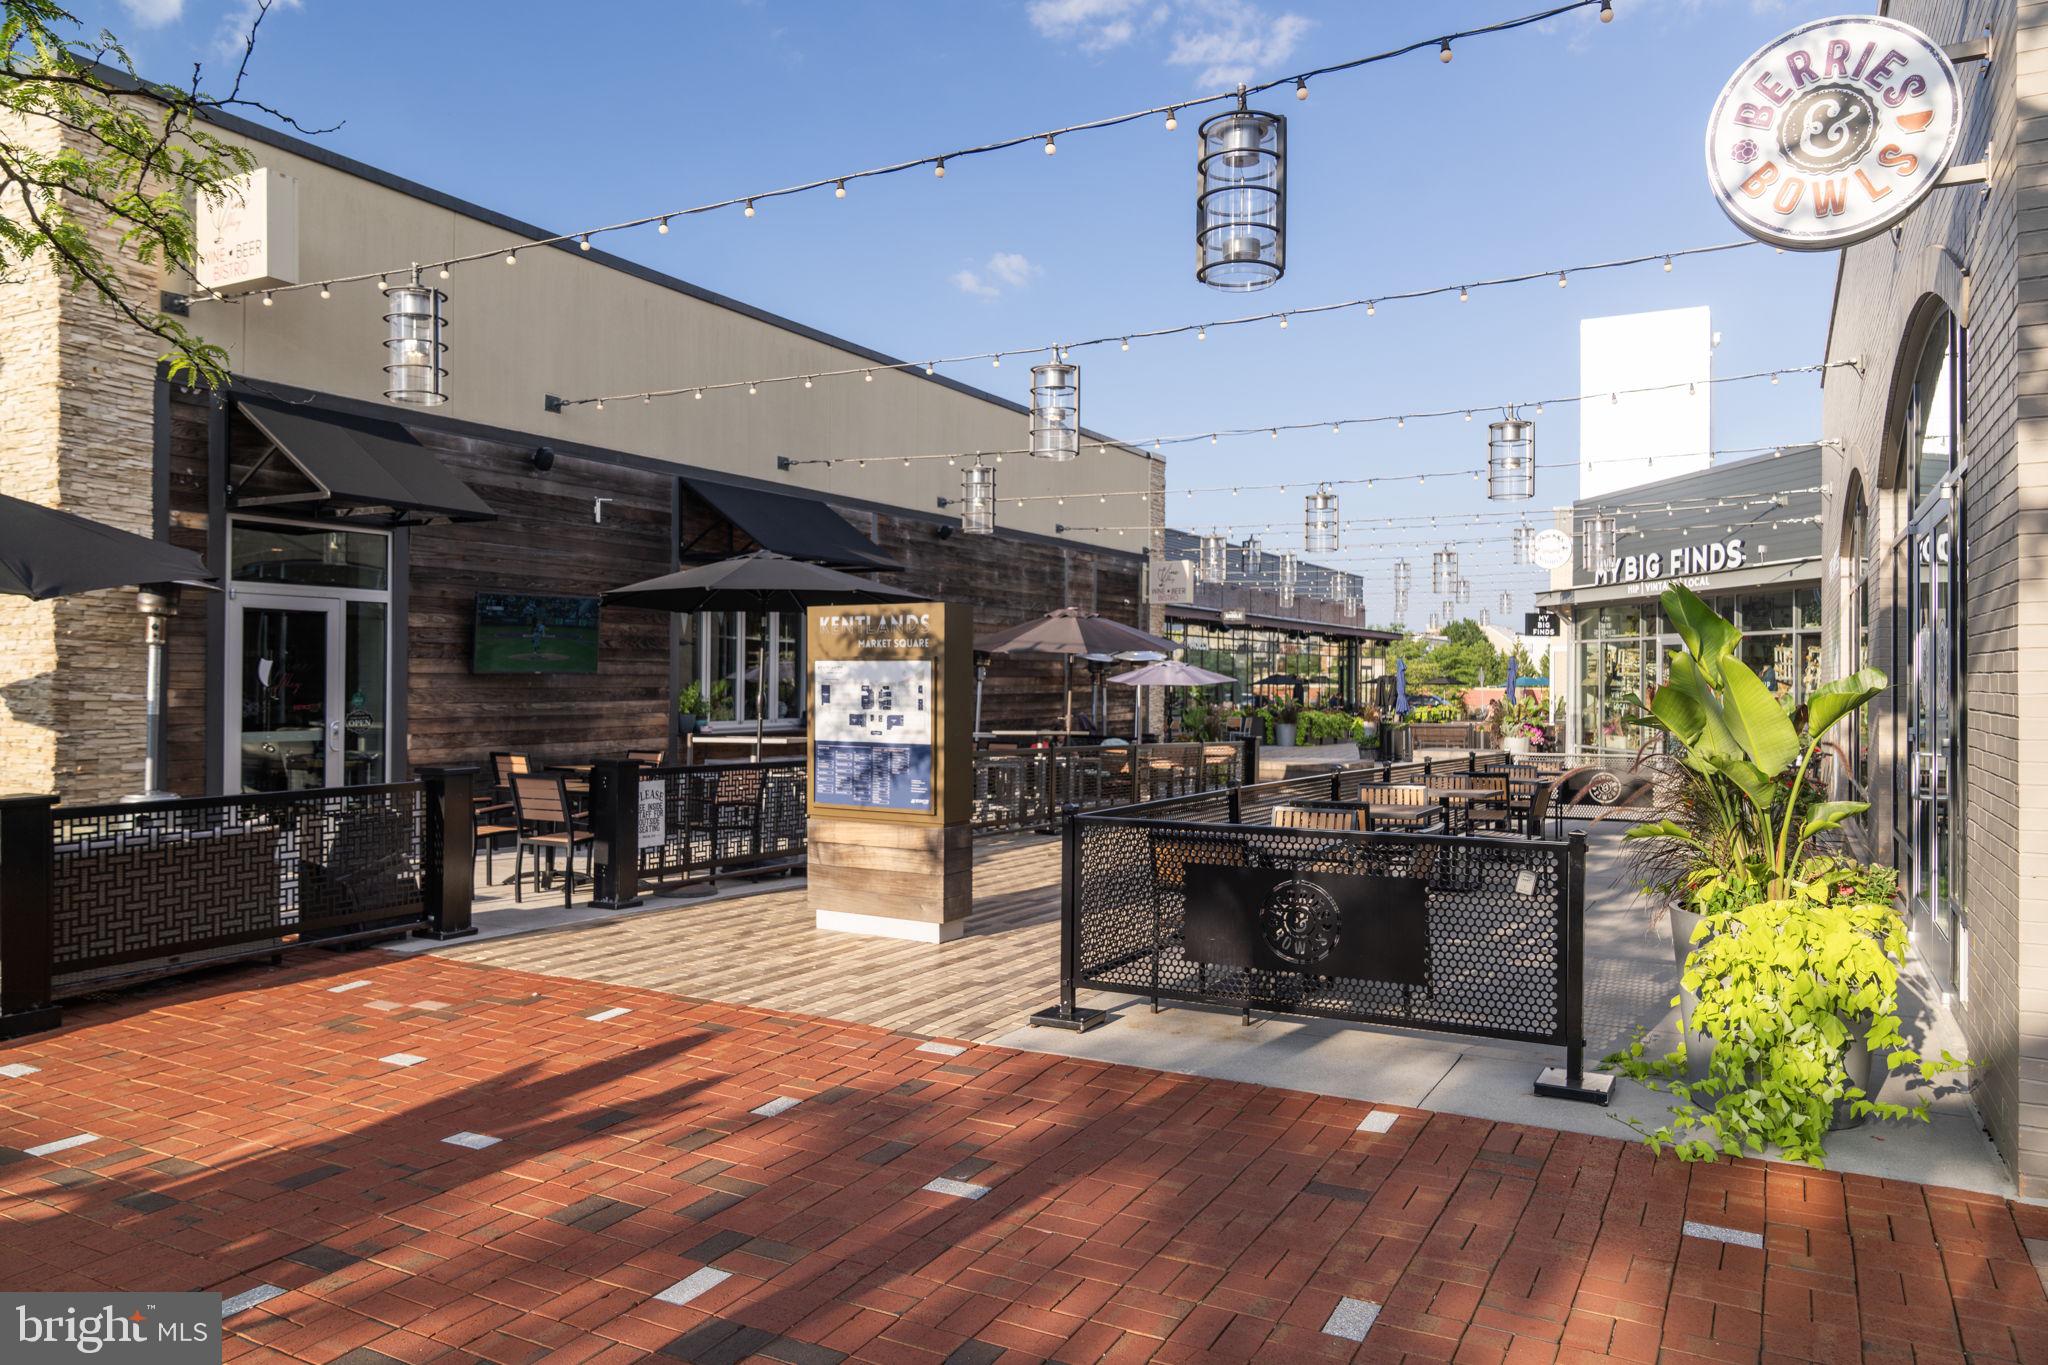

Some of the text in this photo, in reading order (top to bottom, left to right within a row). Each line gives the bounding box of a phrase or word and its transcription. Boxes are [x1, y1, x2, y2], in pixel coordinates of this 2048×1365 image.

[1733, 39, 1928, 130] BERRIES
[1799, 98, 1861, 158] &
[1740, 143, 1918, 218] BOWLS
[236, 239, 262, 259] BEER
[213, 260, 249, 281] BISTRO
[1595, 538, 1743, 586] MY BIG FINDS
[1171, 587, 1186, 595] BEER
[1627, 576, 1710, 594] HIP VINTA LOCAL
[819, 613, 930, 634] KENTLANDS
[858, 638, 929, 648] MARKET SQUARE
[348, 718, 371, 728] OPEN
[640, 789, 664, 801] LEASE
[640, 809, 663, 819] TAFF FOR
[648, 802, 663, 811] INSIDE
